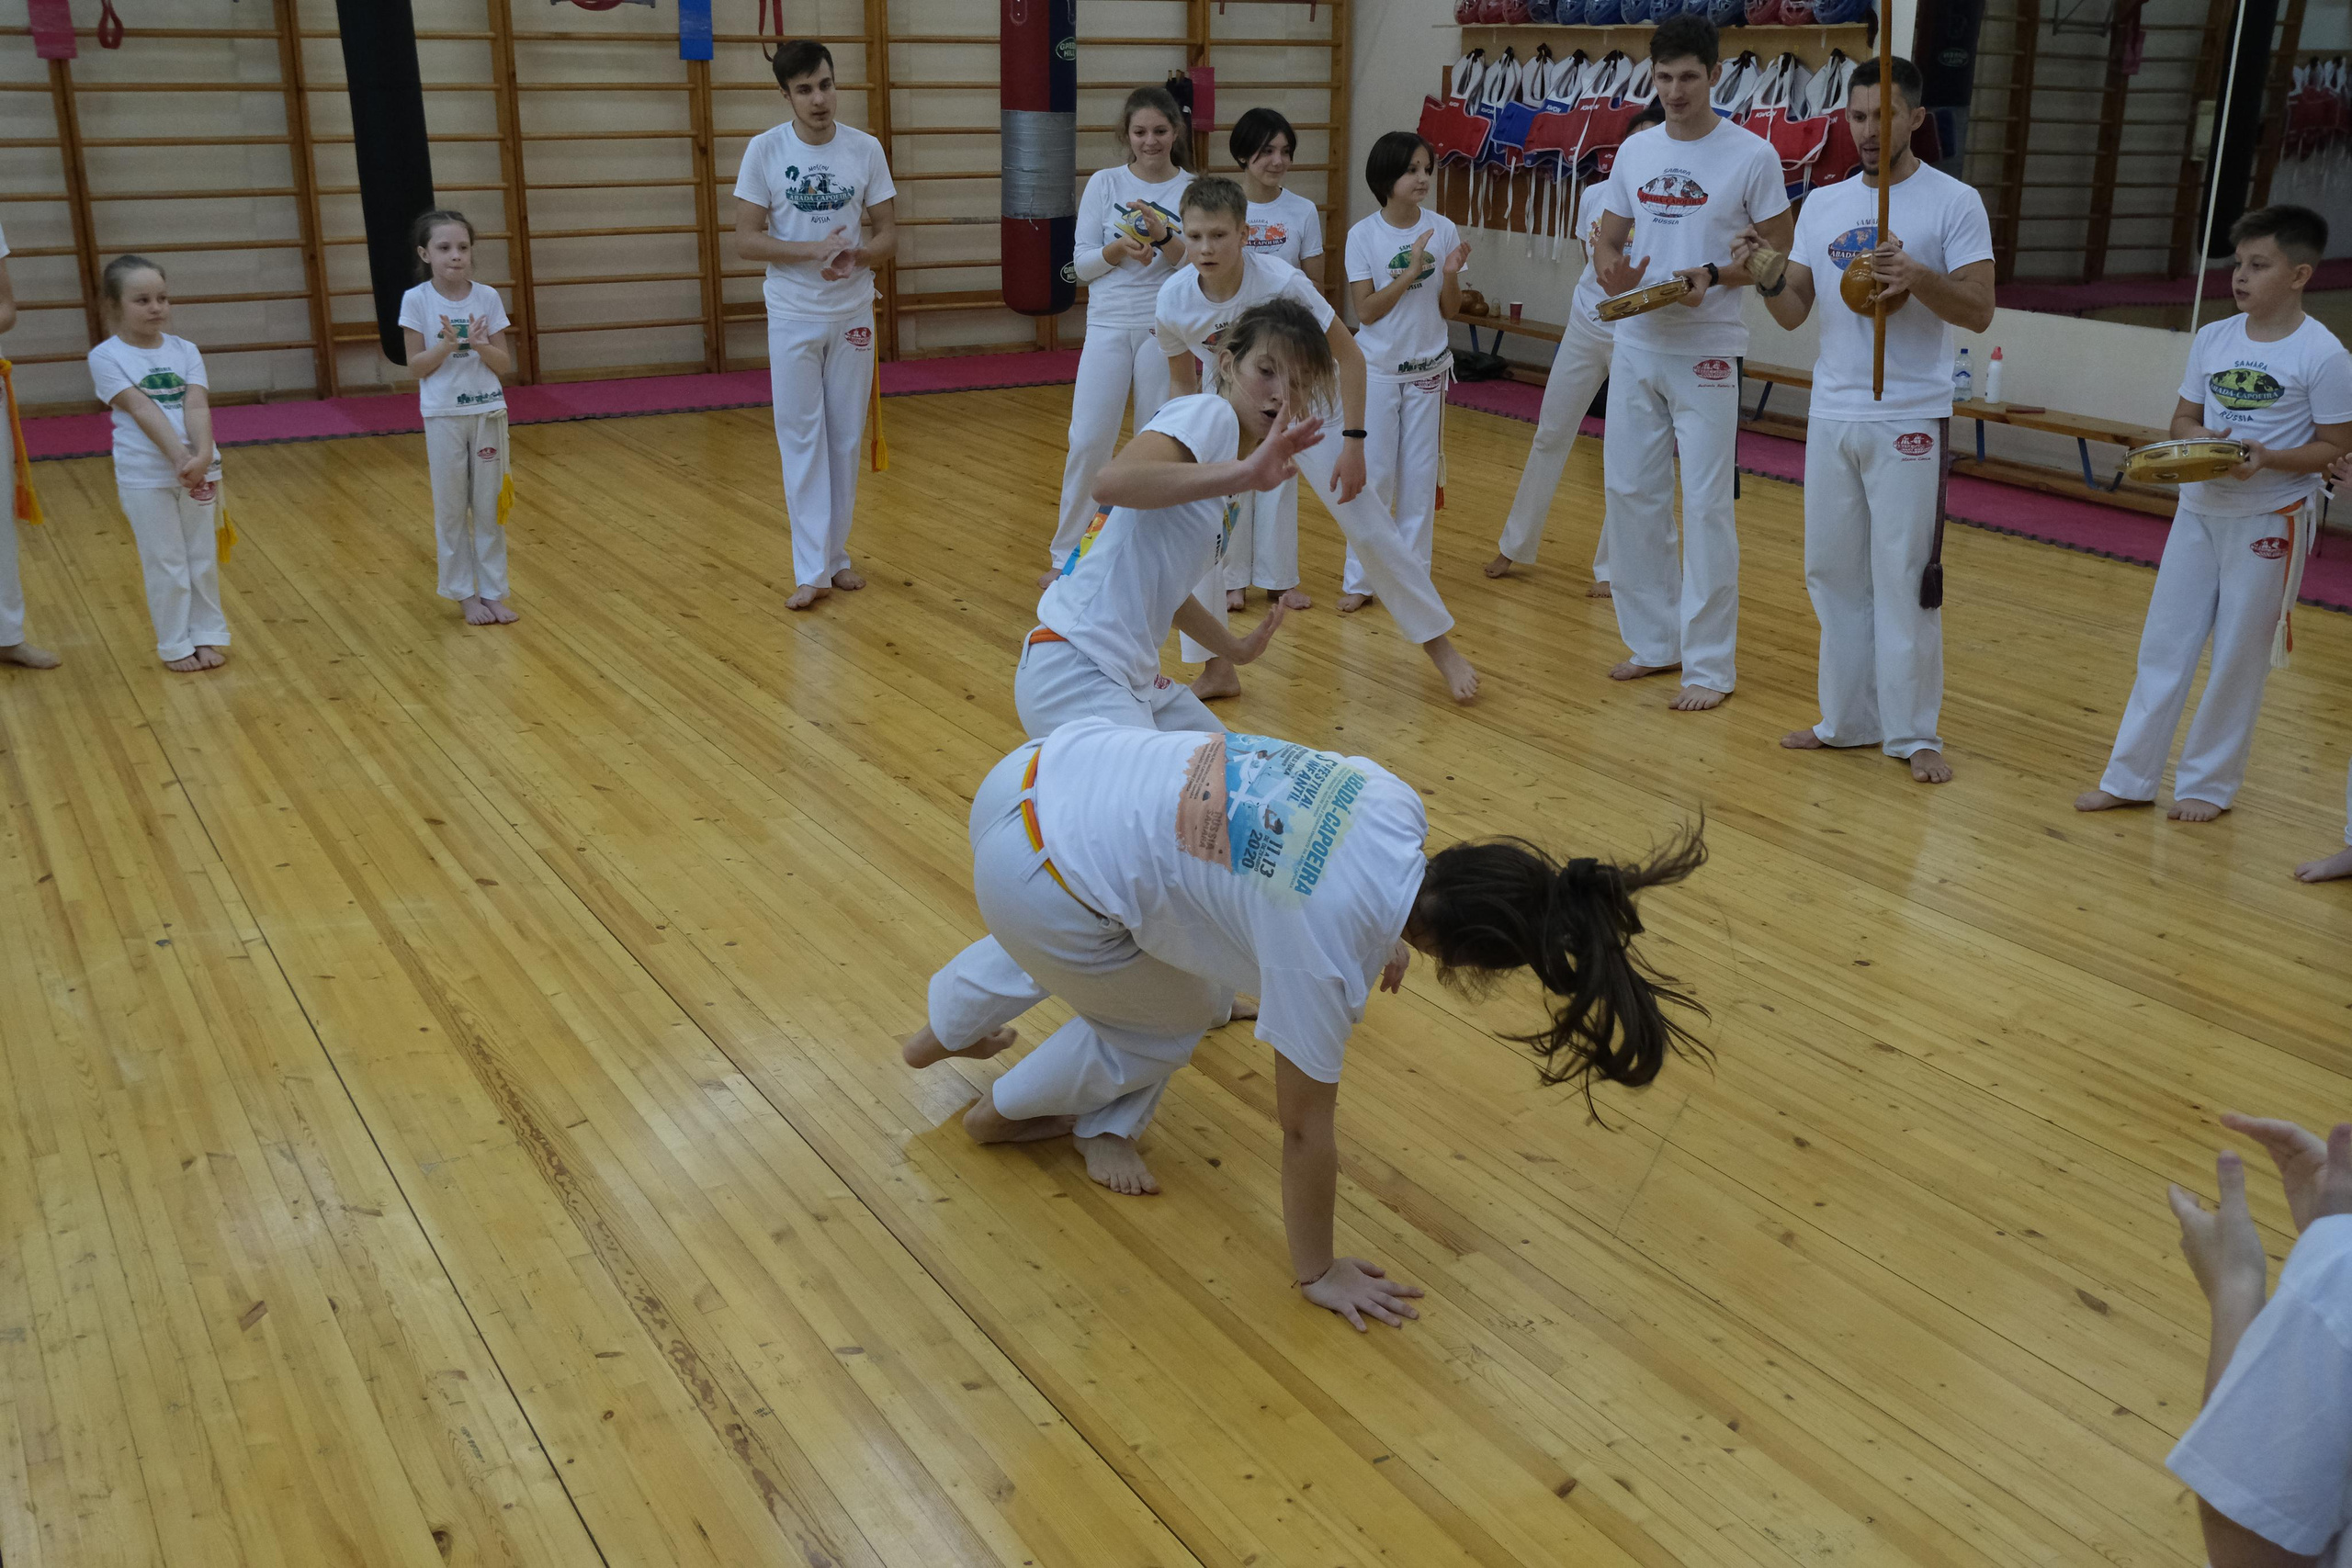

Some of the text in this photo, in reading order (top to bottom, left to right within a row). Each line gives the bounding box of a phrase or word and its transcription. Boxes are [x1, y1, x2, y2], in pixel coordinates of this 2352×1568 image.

[1663, 167, 1691, 176] SAMARA
[2234, 360, 2268, 371] SAMARA
[1287, 760, 1321, 802] INFANTIL
[1298, 764, 1333, 809] FESTIVAL
[1241, 829, 1263, 869] 2020
